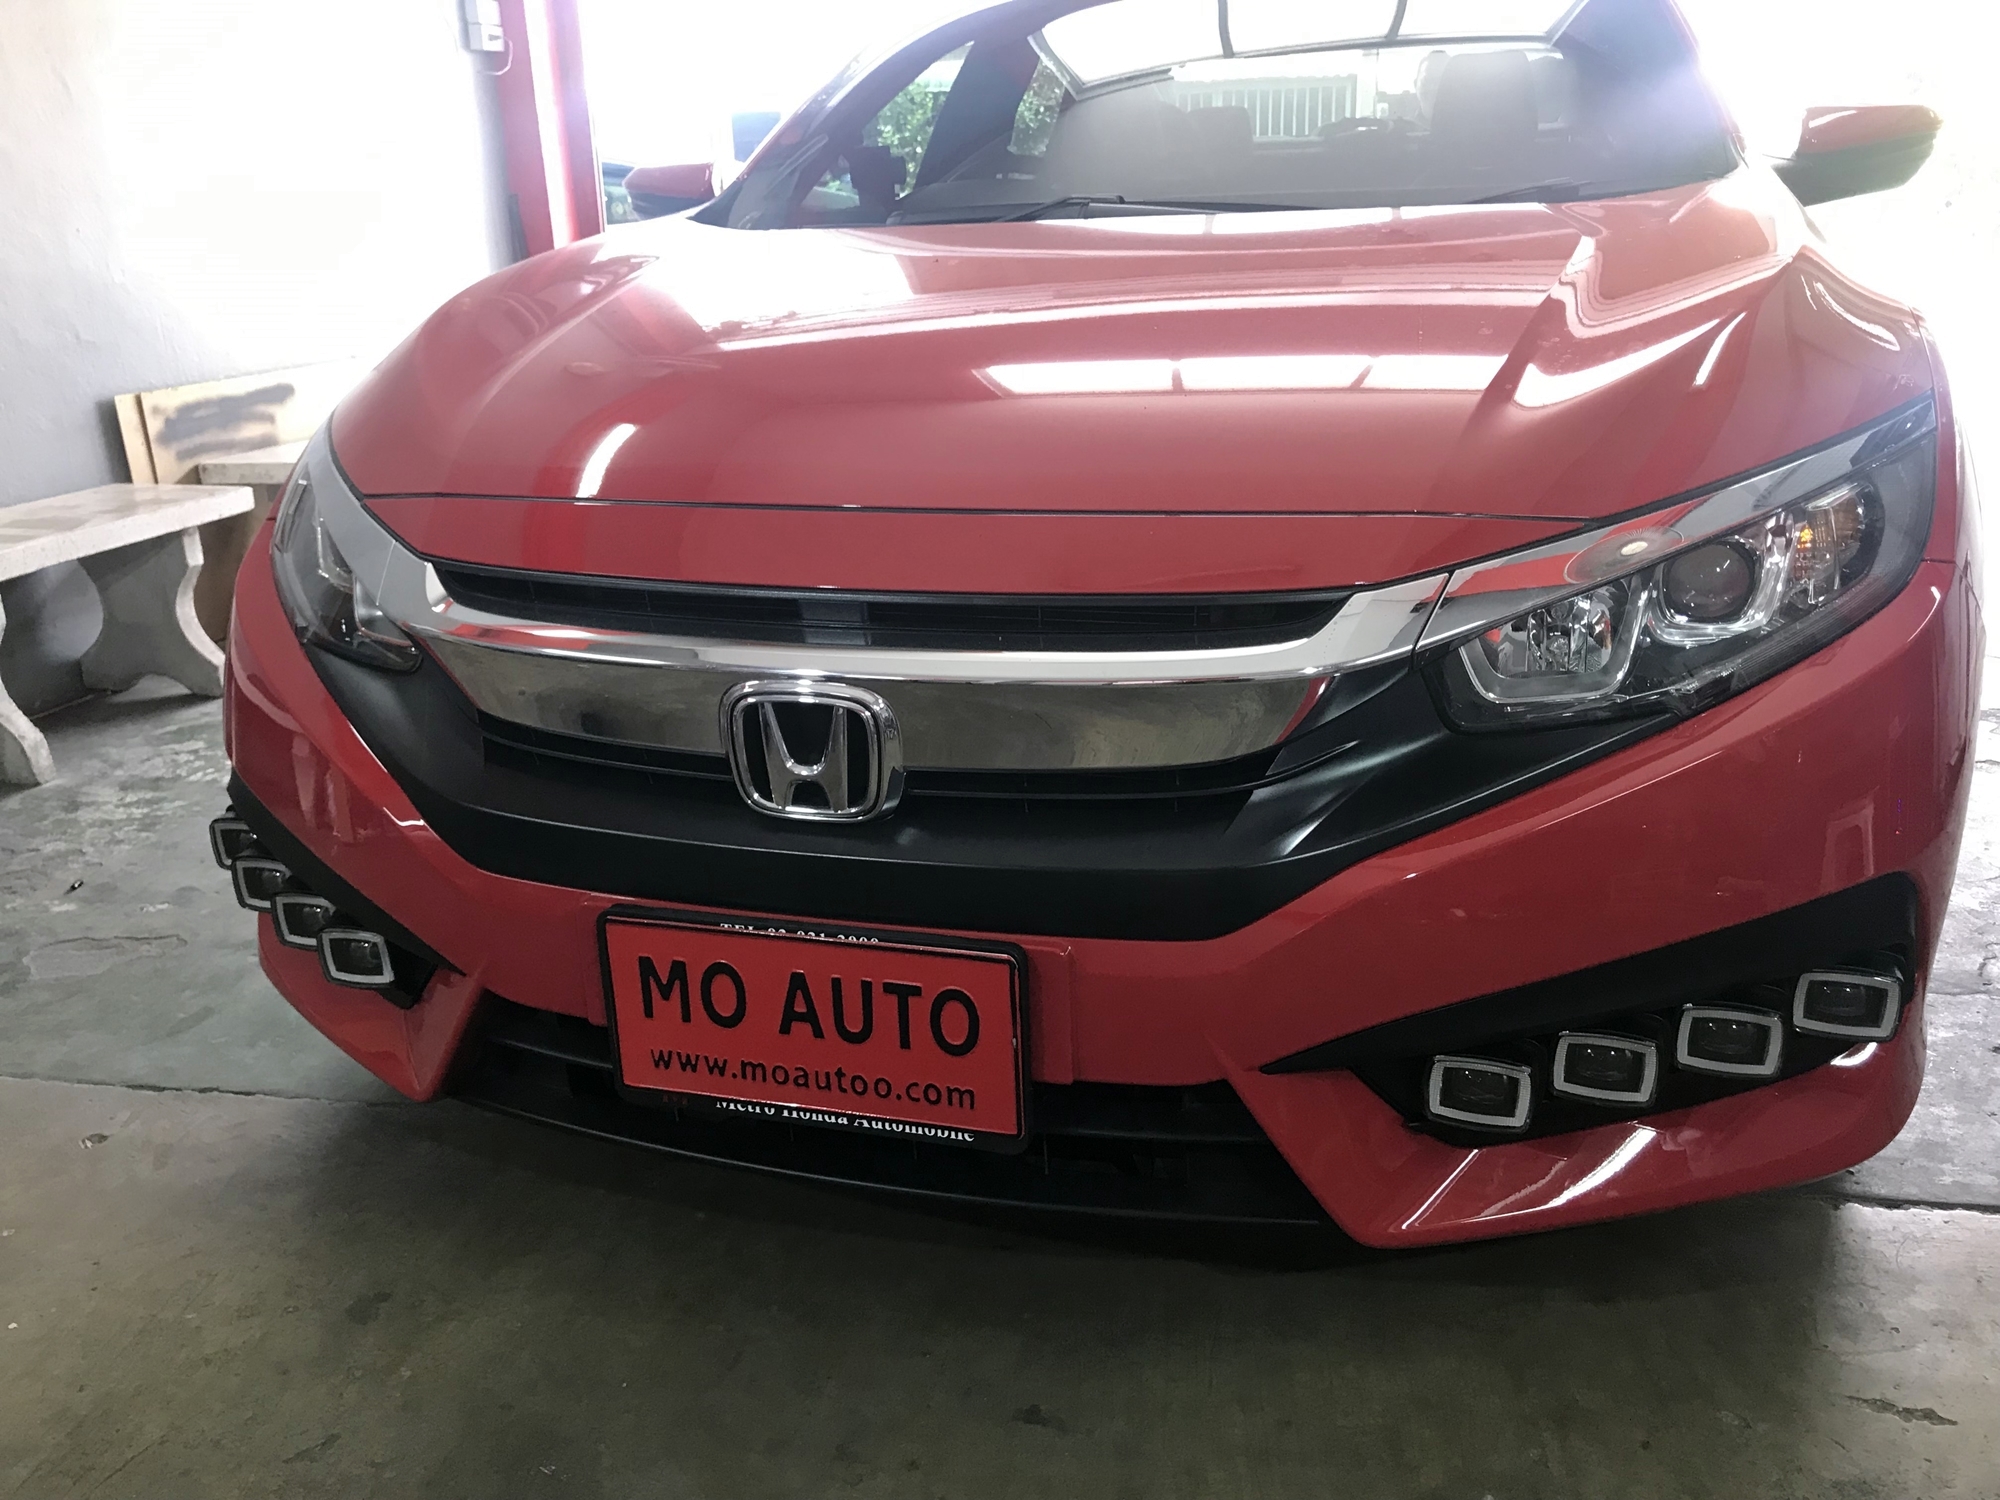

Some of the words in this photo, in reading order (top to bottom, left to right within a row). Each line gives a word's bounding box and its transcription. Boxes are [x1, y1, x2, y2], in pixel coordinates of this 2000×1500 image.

[638, 955, 747, 1029] MO
[779, 970, 980, 1056] AUTO
[651, 1049, 976, 1111] www.moautoo.com
